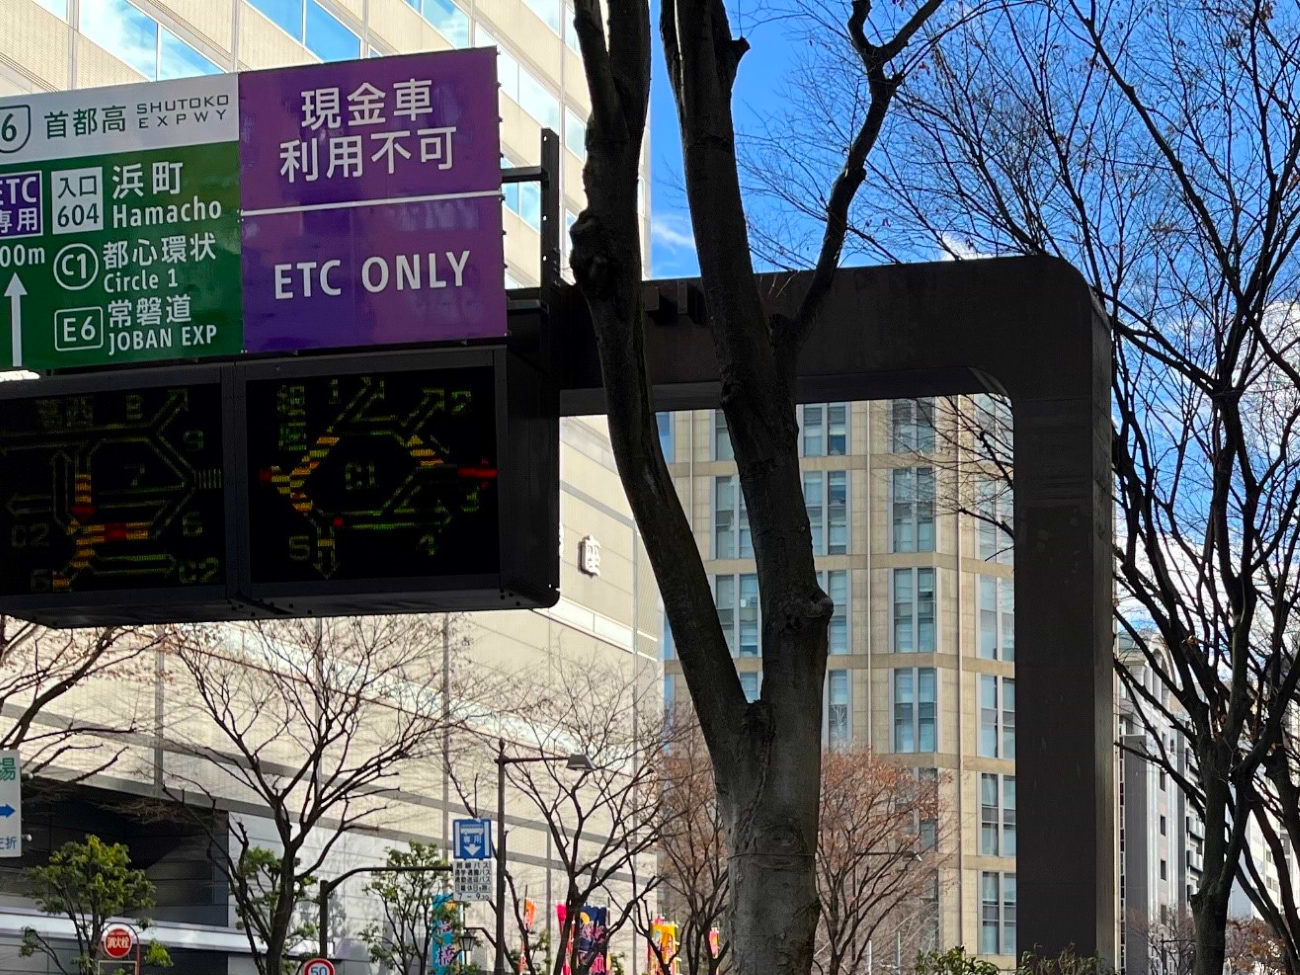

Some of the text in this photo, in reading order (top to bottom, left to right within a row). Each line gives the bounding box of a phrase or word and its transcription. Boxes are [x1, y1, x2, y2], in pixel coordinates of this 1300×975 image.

[136, 94, 229, 114] SHUTOKO
[301, 78, 434, 131] 現金車
[1, 112, 17, 142] 6
[44, 104, 127, 139] 首都高
[279, 126, 457, 183] 利用不可
[0, 176, 37, 204] TC
[57, 175, 97, 199] 入口
[112, 161, 183, 199] 浜町
[57, 203, 99, 227] 604
[112, 196, 222, 229] Hamacho
[61, 253, 87, 280] C1
[103, 232, 216, 271] 都心環状
[103, 268, 179, 293] Circle 1
[274, 250, 471, 300] ETC ONLY
[107, 293, 192, 329] 常磐道
[63, 316, 96, 342] E6
[108, 324, 217, 356] JOBAN EXP
